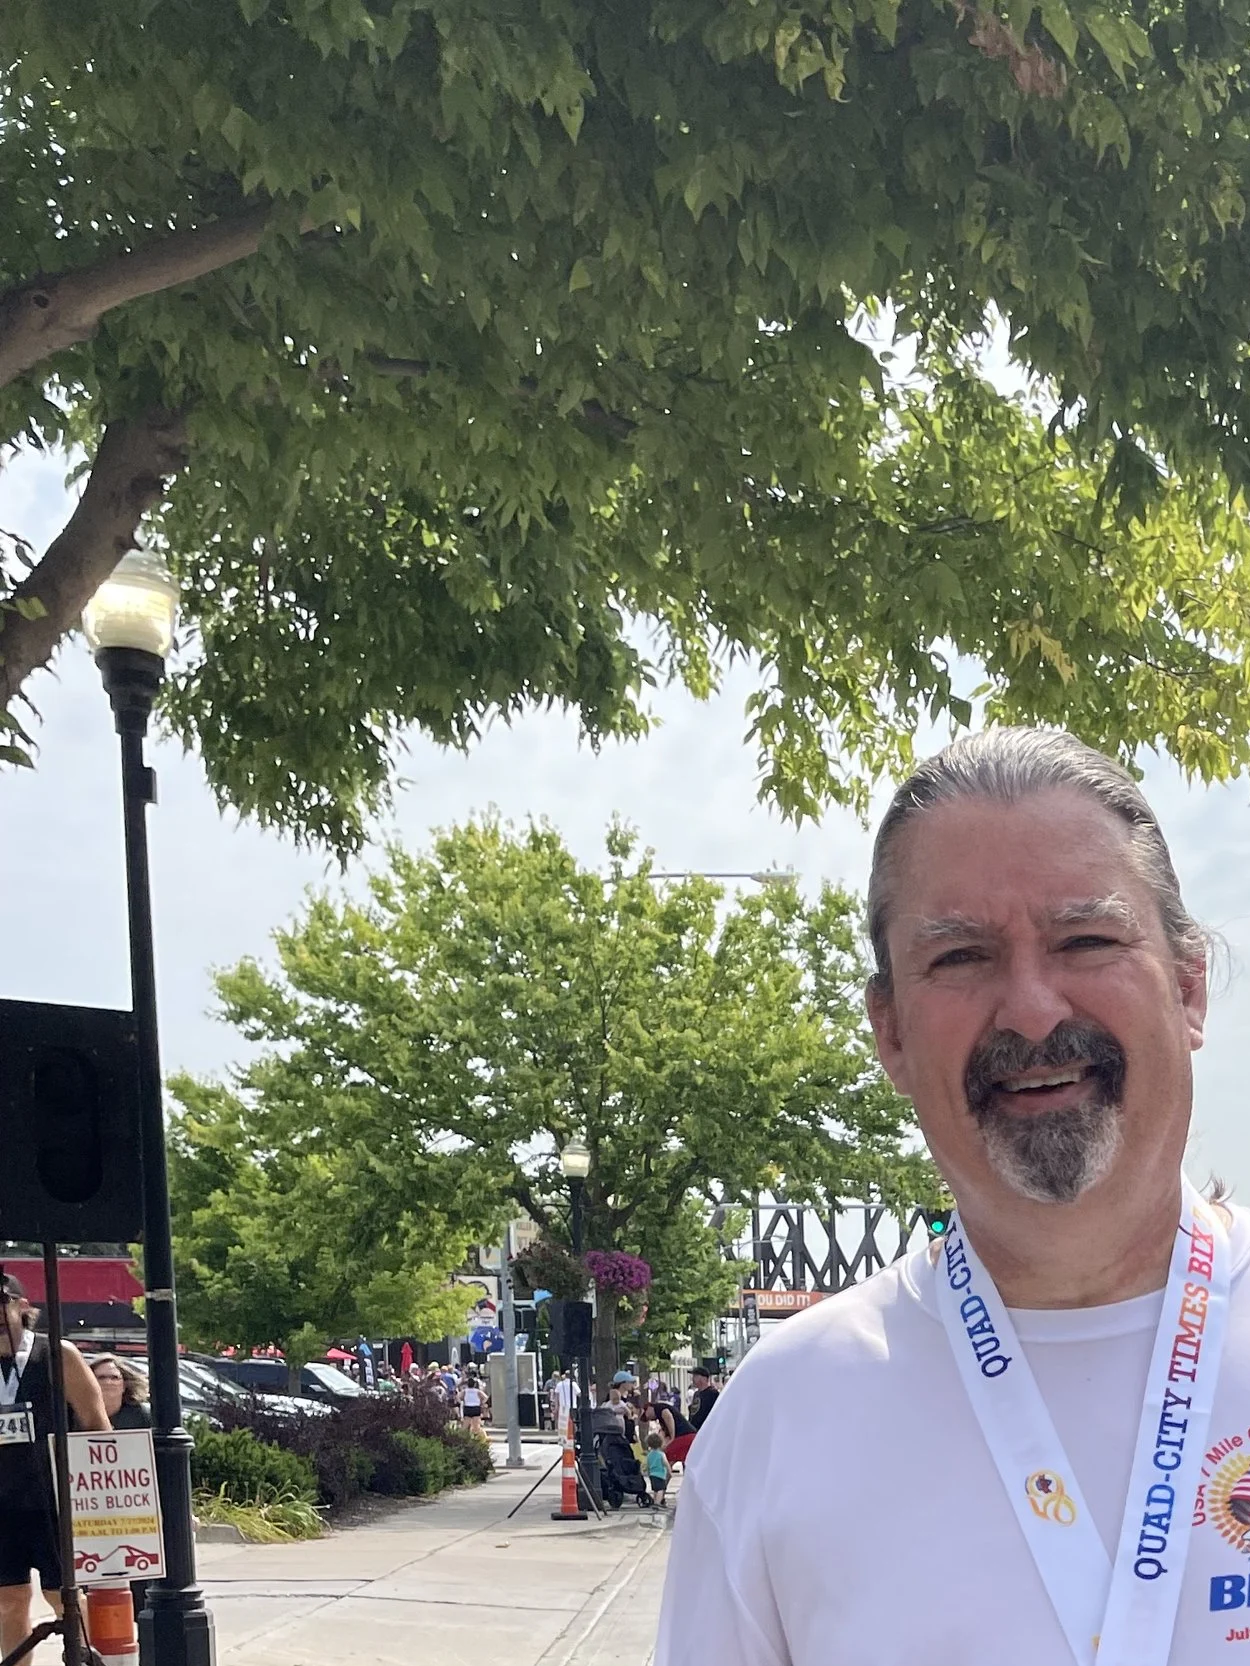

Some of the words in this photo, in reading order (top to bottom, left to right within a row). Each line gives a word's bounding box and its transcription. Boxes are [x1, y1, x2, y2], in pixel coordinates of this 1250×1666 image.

[1188, 1222, 1214, 1282] BIX
[758, 1294, 773, 1306] OU
[775, 1294, 795, 1306] DID
[796, 1295, 811, 1307] IT!
[1168, 1282, 1209, 1384] TIMES
[88, 1444, 119, 1465] NO
[1205, 1435, 1244, 1466] Mile
[1134, 1387, 1192, 1580] QUAD-CITY
[105, 1493, 151, 1510] BLOCK
[74, 1518, 117, 1528] ATURDAY
